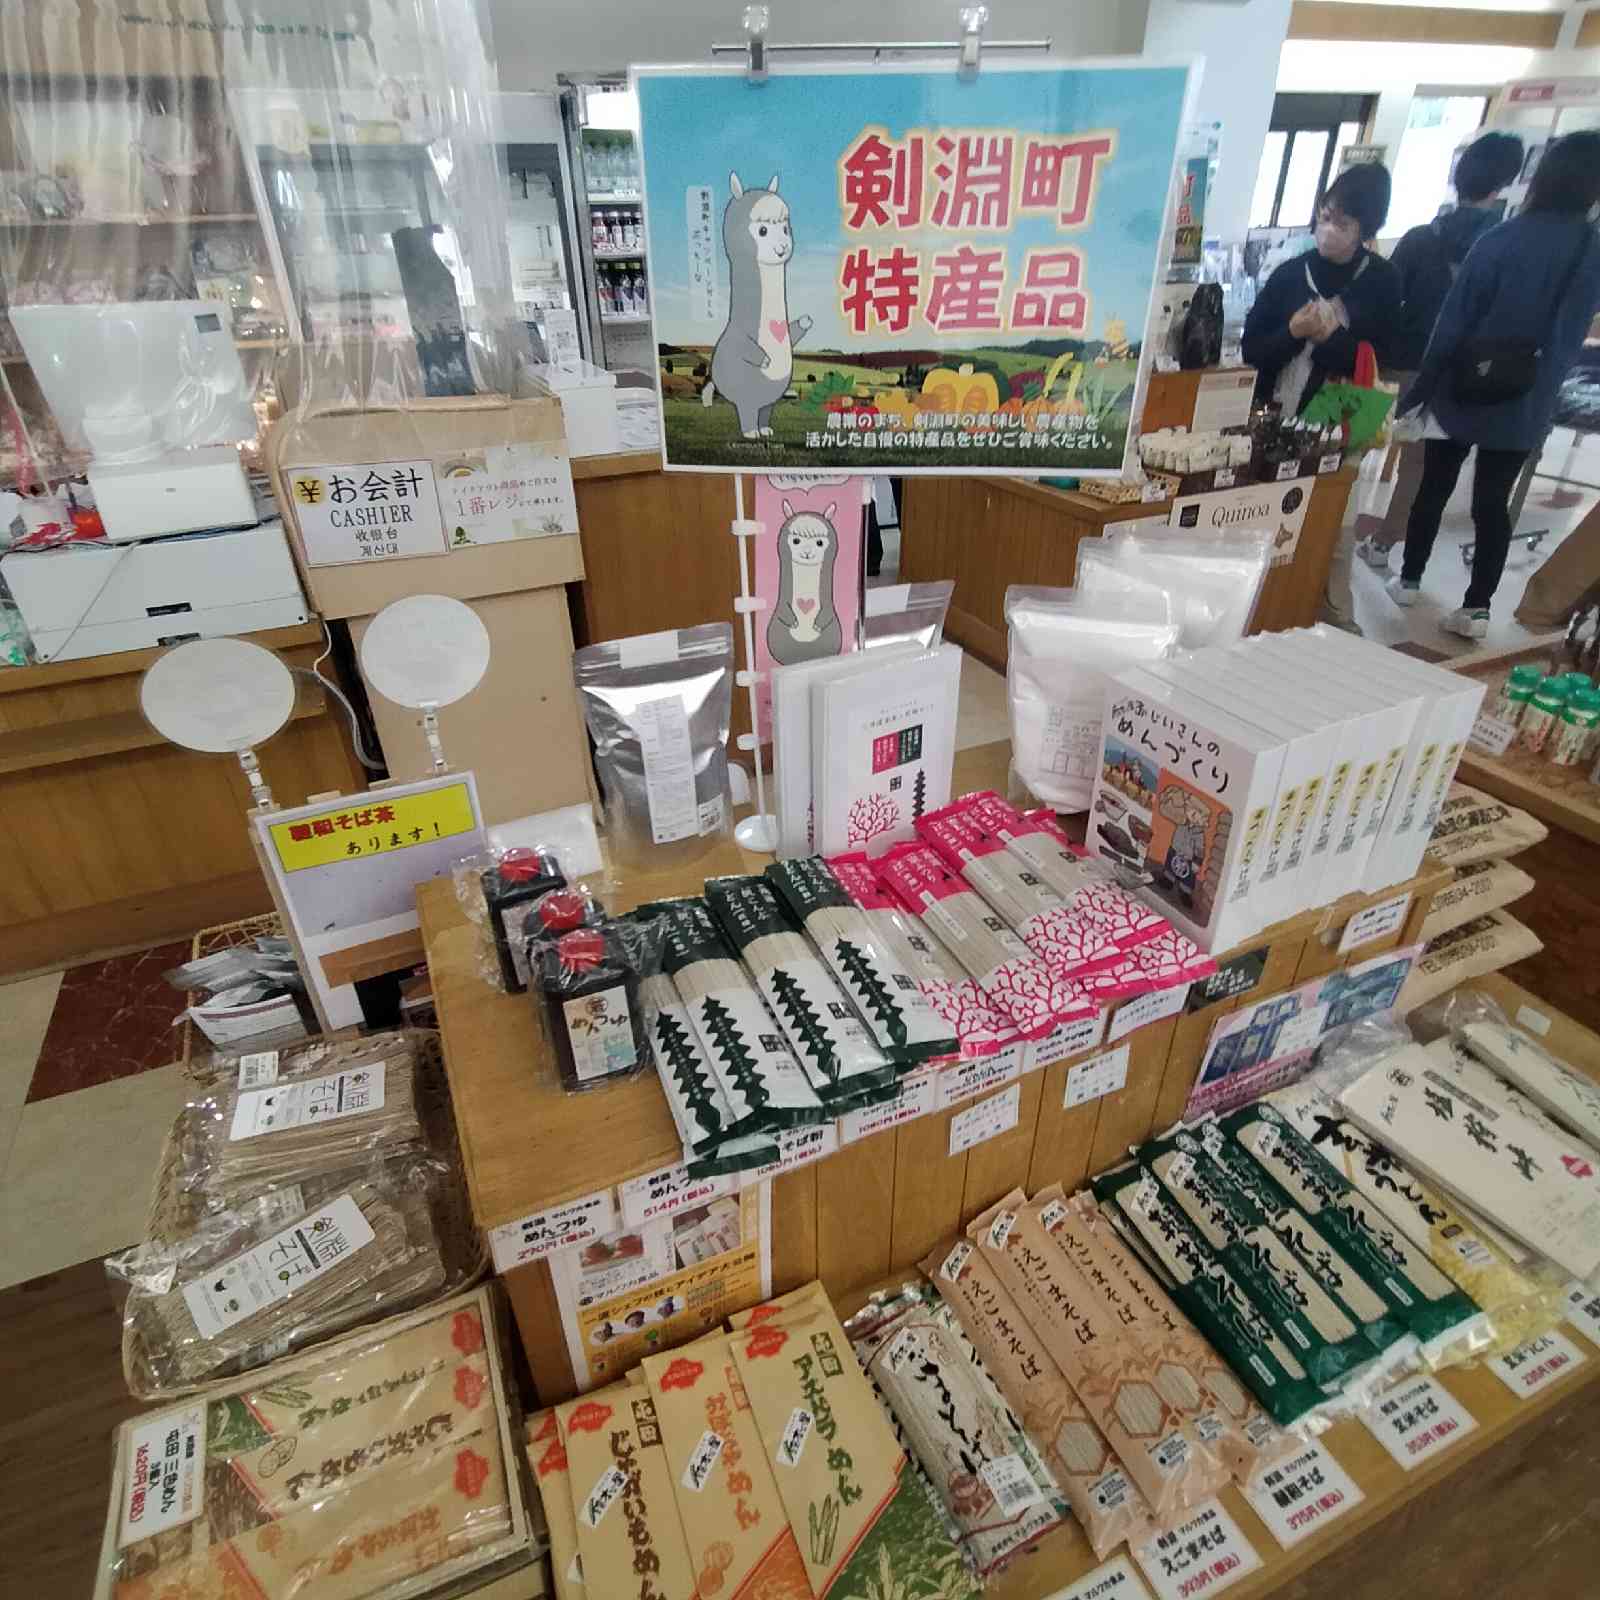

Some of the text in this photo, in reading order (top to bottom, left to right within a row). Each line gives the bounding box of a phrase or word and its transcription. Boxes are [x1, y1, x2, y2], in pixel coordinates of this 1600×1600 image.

[843, 131, 1110, 231] 剣淵町
[841, 247, 1088, 332] 特産品
[329, 468, 423, 503] お会計
[331, 504, 413, 528] CASHIER
[1212, 503, 1271, 528] Quinoa
[1118, 718, 1228, 793] めんづくり
[650, 1178, 692, 1200] めんつ
[524, 1216, 587, 1243] めんつゆ
[1022, 1247, 1097, 1345] えごまそば
[1065, 1232, 1138, 1326] えごまそば
[971, 1279, 1042, 1381] えごまそば
[1160, 1525, 1227, 1576] えごまそば
